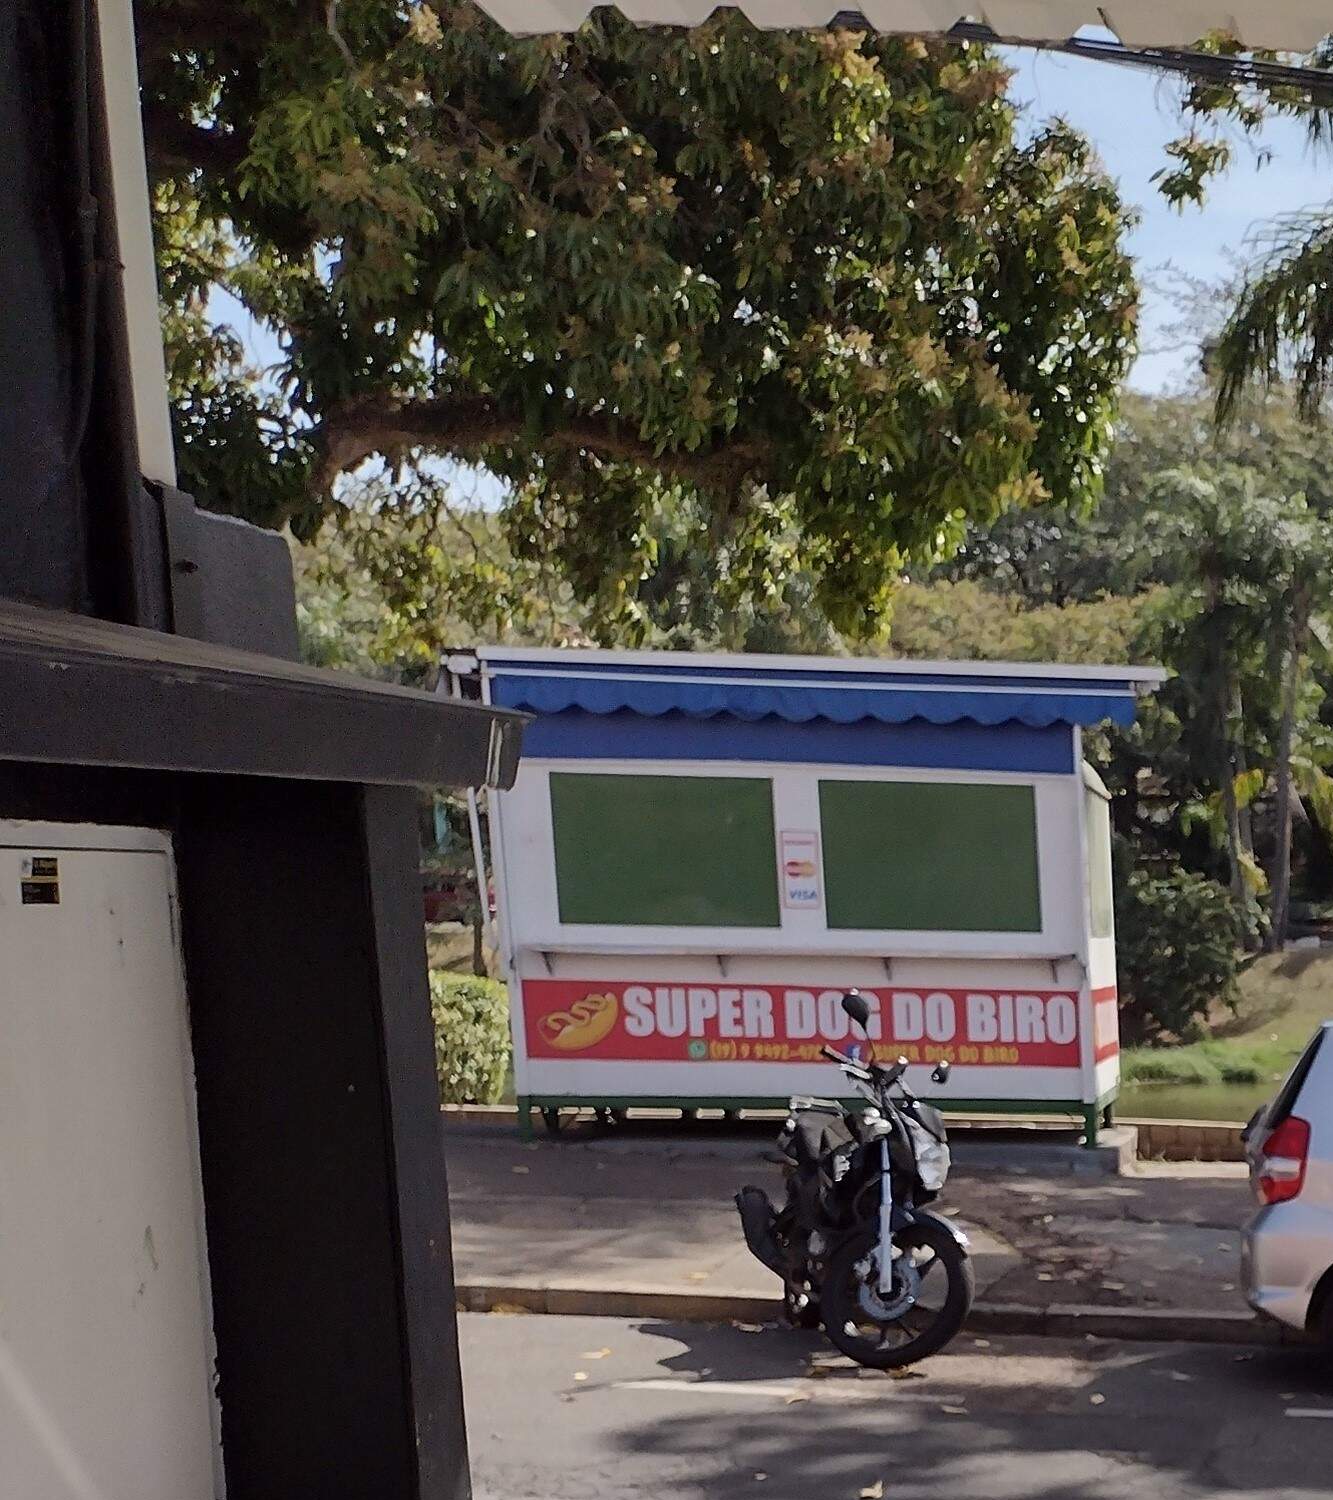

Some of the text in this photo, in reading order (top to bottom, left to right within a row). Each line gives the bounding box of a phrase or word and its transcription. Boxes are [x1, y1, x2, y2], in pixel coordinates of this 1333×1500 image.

[790, 889, 818, 900] VISA
[622, 985, 1077, 1045] SUPER DOG DO BIRO
